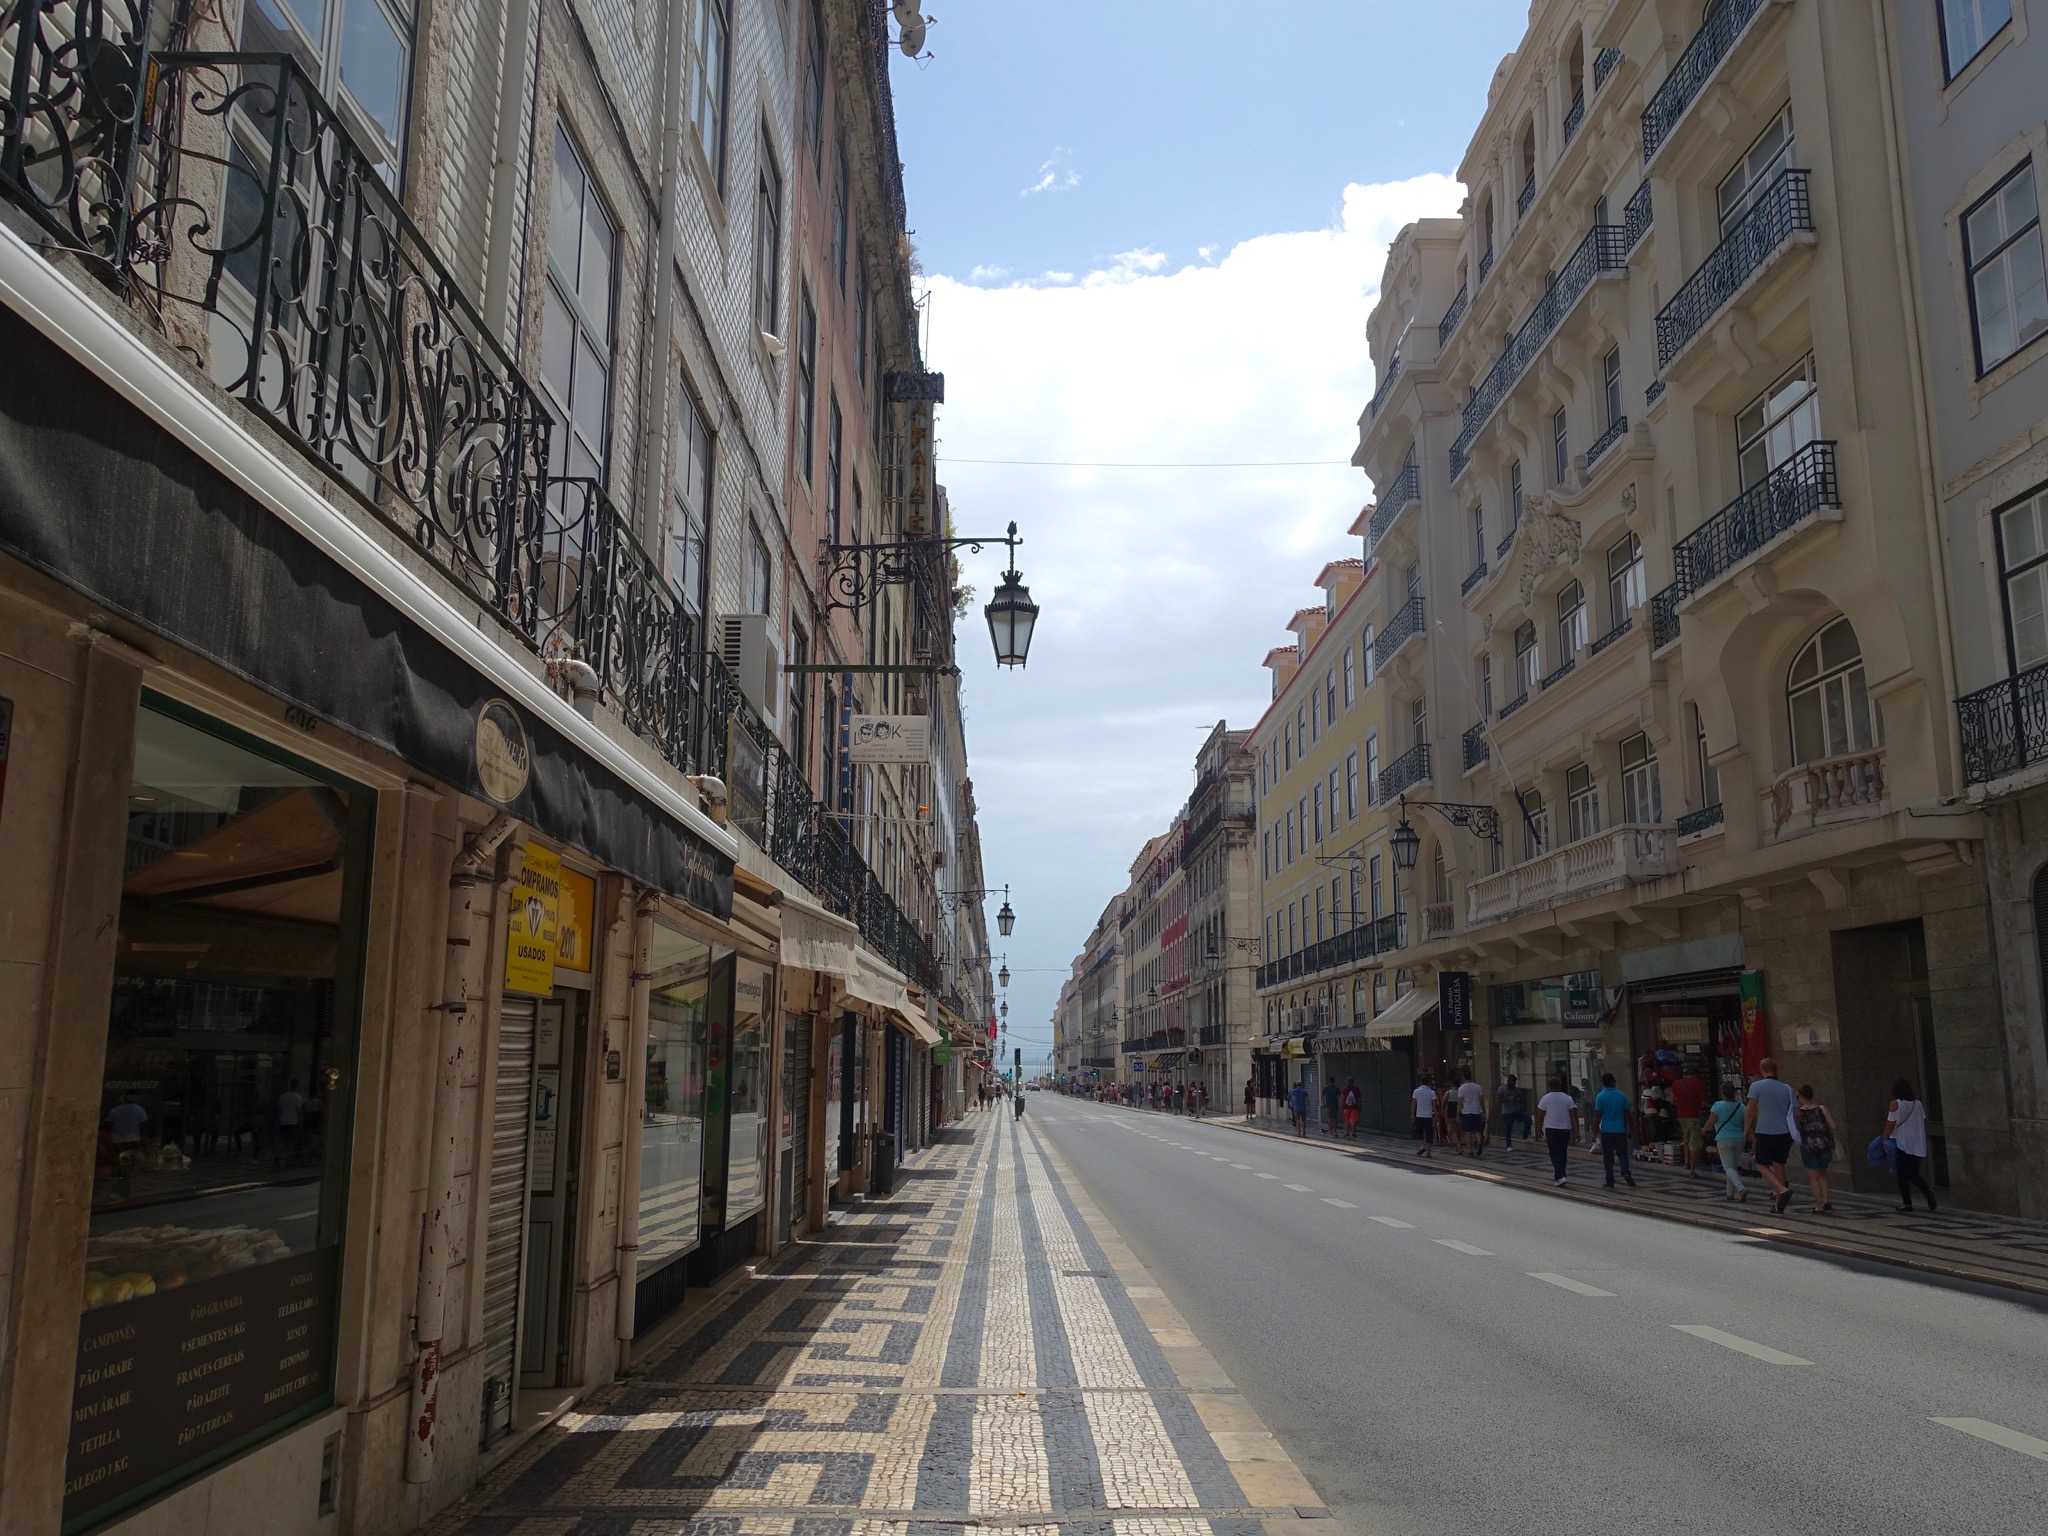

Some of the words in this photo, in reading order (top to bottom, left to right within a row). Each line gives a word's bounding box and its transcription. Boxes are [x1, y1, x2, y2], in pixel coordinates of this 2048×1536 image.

[518, 945, 546, 962] USADOS
[560, 925, 576, 961] 200
[737, 979, 761, 999] dermalogica
[1453, 978, 1462, 1025] PORTUGUESA
[190, 1303, 208, 1321] PÃO
[83, 1322, 137, 1353] CAMPONÊS
[187, 1328, 228, 1352] SEMENTES
[234, 1320, 247, 1335] KG
[79, 1367, 100, 1388] PÃO
[101, 1356, 135, 1381] ÁRABE
[213, 1350, 246, 1374] CEREAIS
[280, 1350, 310, 1371] REDONDO
[186, 1394, 204, 1412] PÃO
[204, 1382, 232, 1405] AZEITE
[263, 1380, 293, 1404] BAGUETE
[293, 1369, 319, 1393] CEREAIS
[73, 1400, 98, 1425] MINI
[99, 1390, 133, 1415] ÁRABE
[79, 1427, 121, 1455] TETILLA
[178, 1428, 195, 1446] PÃO
[201, 1410, 235, 1434] CEREAIS
[64, 1464, 107, 1497] GALEGO
[114, 1455, 130, 1475] KG
